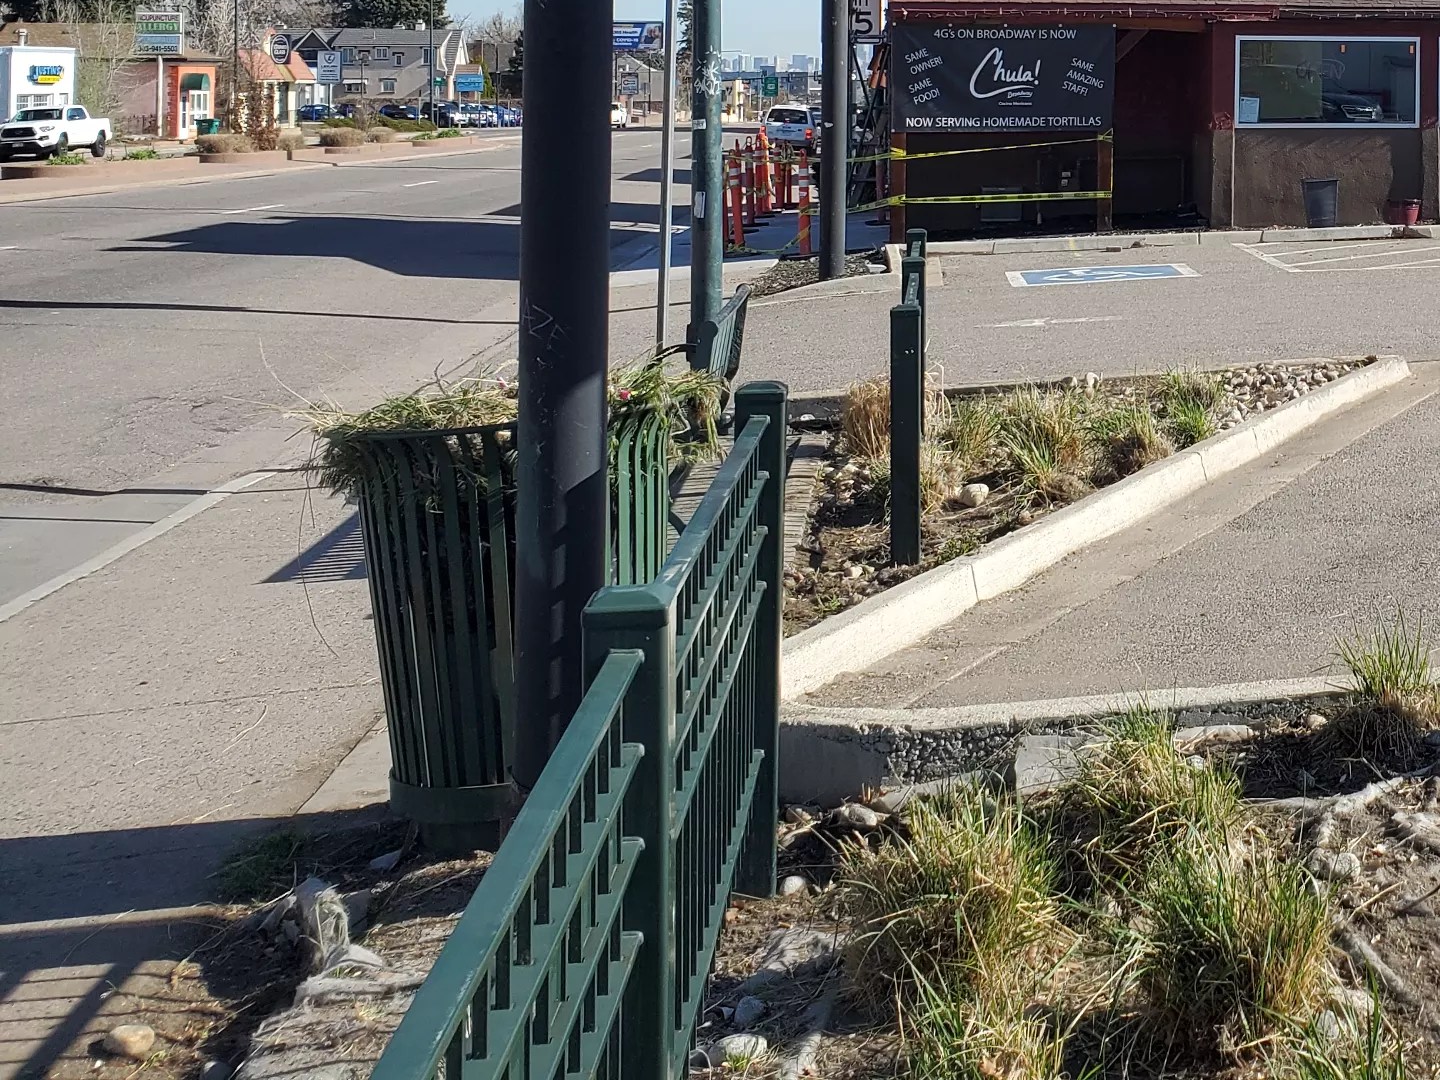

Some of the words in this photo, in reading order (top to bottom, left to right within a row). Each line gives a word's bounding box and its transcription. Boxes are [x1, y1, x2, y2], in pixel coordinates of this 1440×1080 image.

[933, 28, 956, 39] 4G's
[957, 29, 975, 39] ON
[976, 29, 1037, 39] BROADWAY
[1038, 29, 1048, 39] IS
[1050, 29, 1077, 39] NOW
[904, 48, 929, 64] SAME
[910, 56, 943, 75] OWNER!
[969, 47, 1041, 98] Chula!
[1070, 57, 1095, 73] SAME
[908, 77, 933, 94] SAME
[1066, 69, 1105, 89] AMAZING
[1062, 80, 1089, 96] STAFF!
[913, 88, 941, 105] FOOD!
[905, 117, 933, 128] NOW
[935, 117, 980, 128] SERVING
[983, 117, 1046, 127] HOMEMADE
[1047, 116, 1102, 127] TORTILLAS
